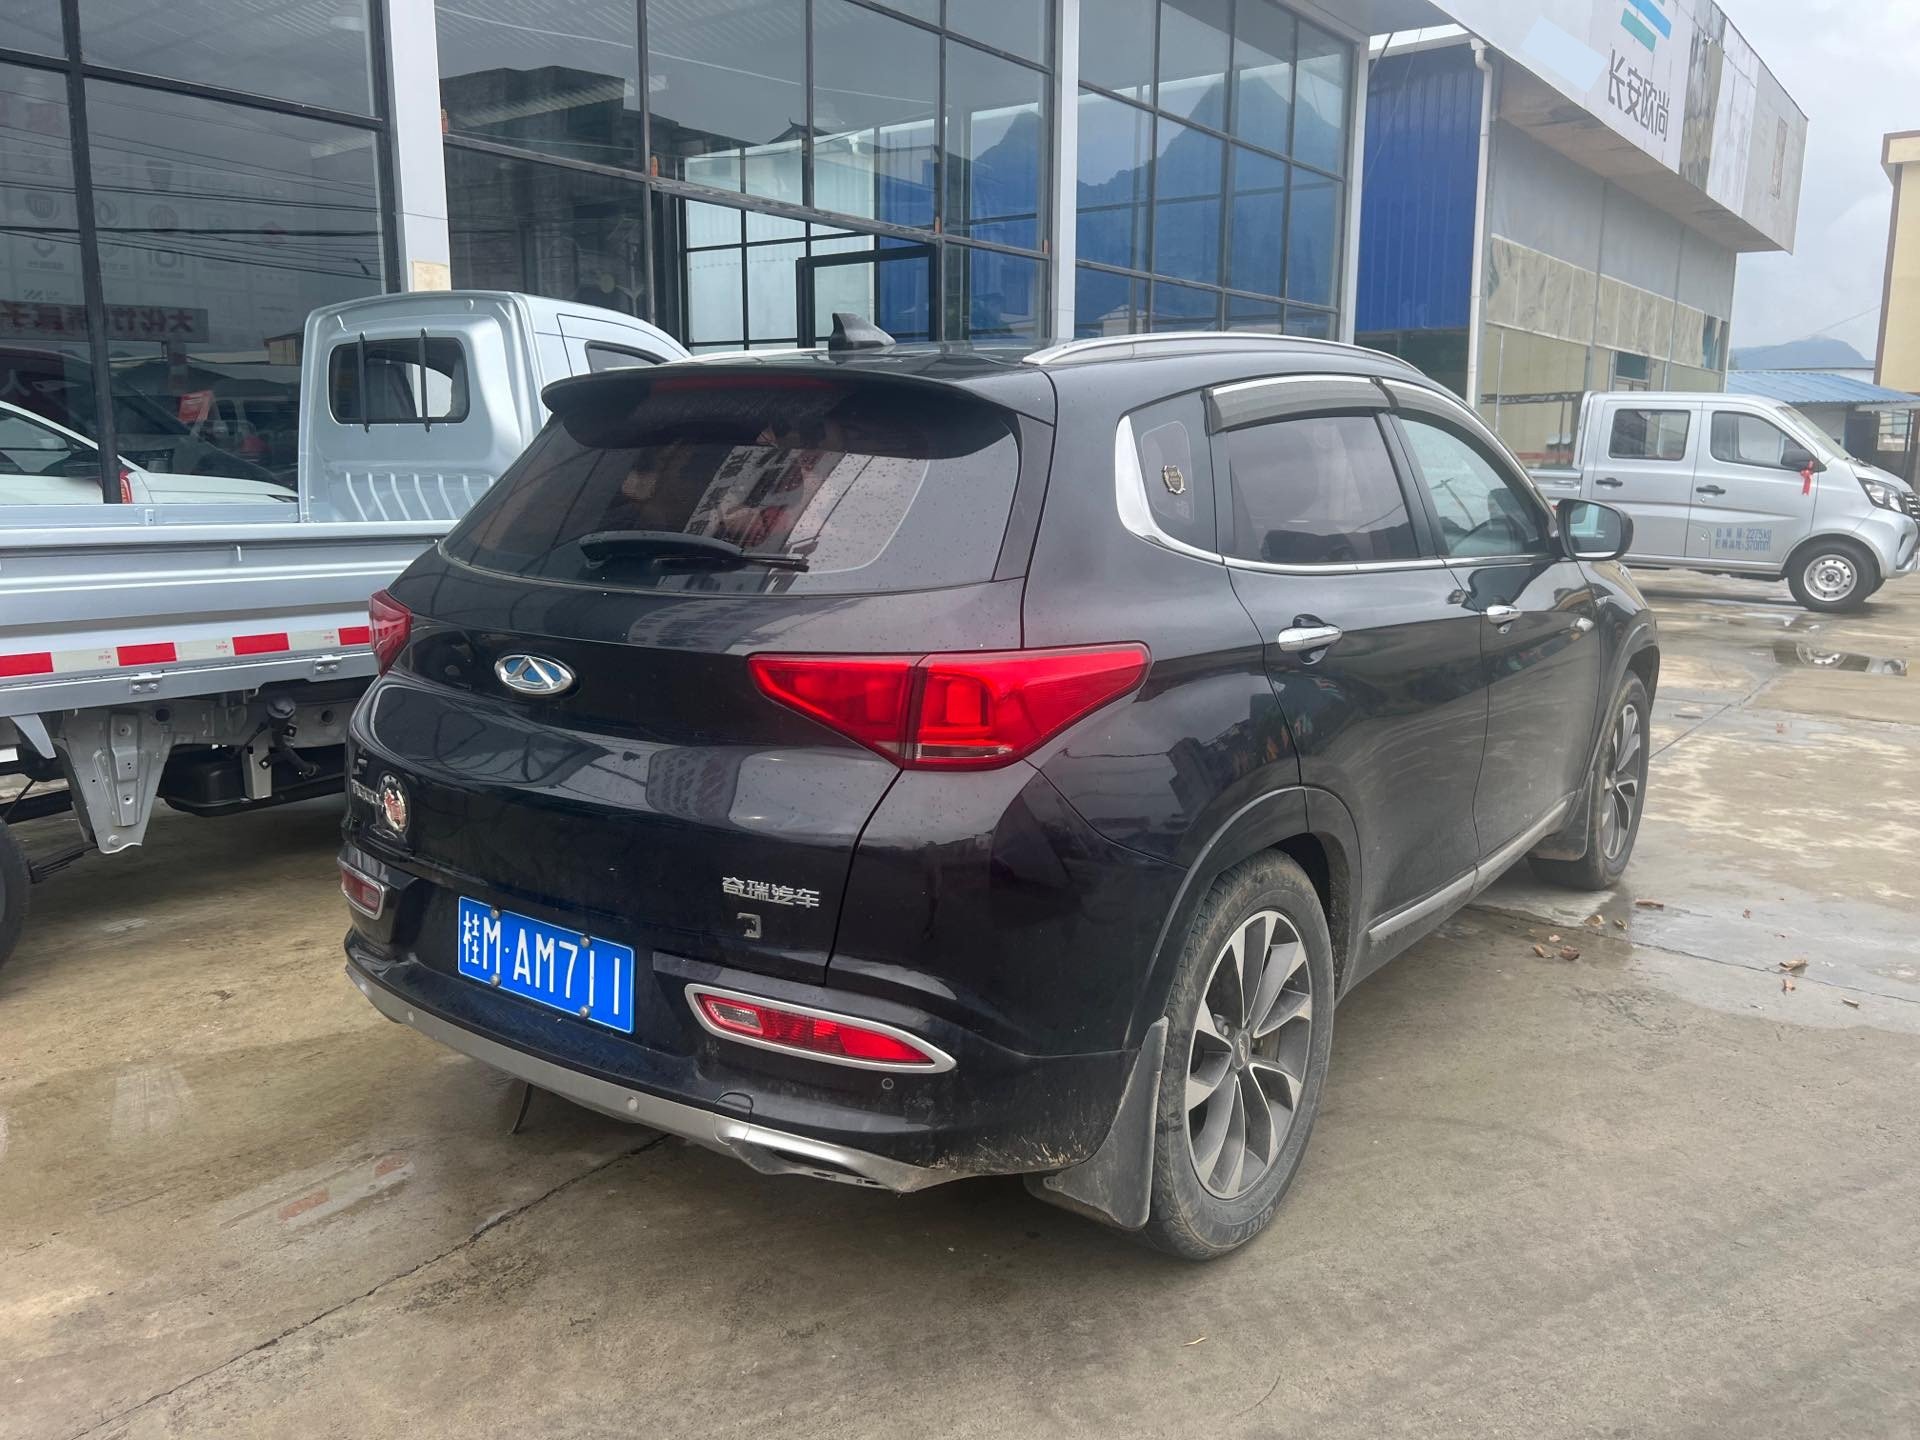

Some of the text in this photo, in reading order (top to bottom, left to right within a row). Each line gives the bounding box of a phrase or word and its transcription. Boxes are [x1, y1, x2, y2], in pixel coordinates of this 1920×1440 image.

[1608, 49, 1669, 142] 长安欧尚
[722, 877, 820, 908] 奇瑞汽车
[463, 911, 620, 1015] 桂M·AM711
